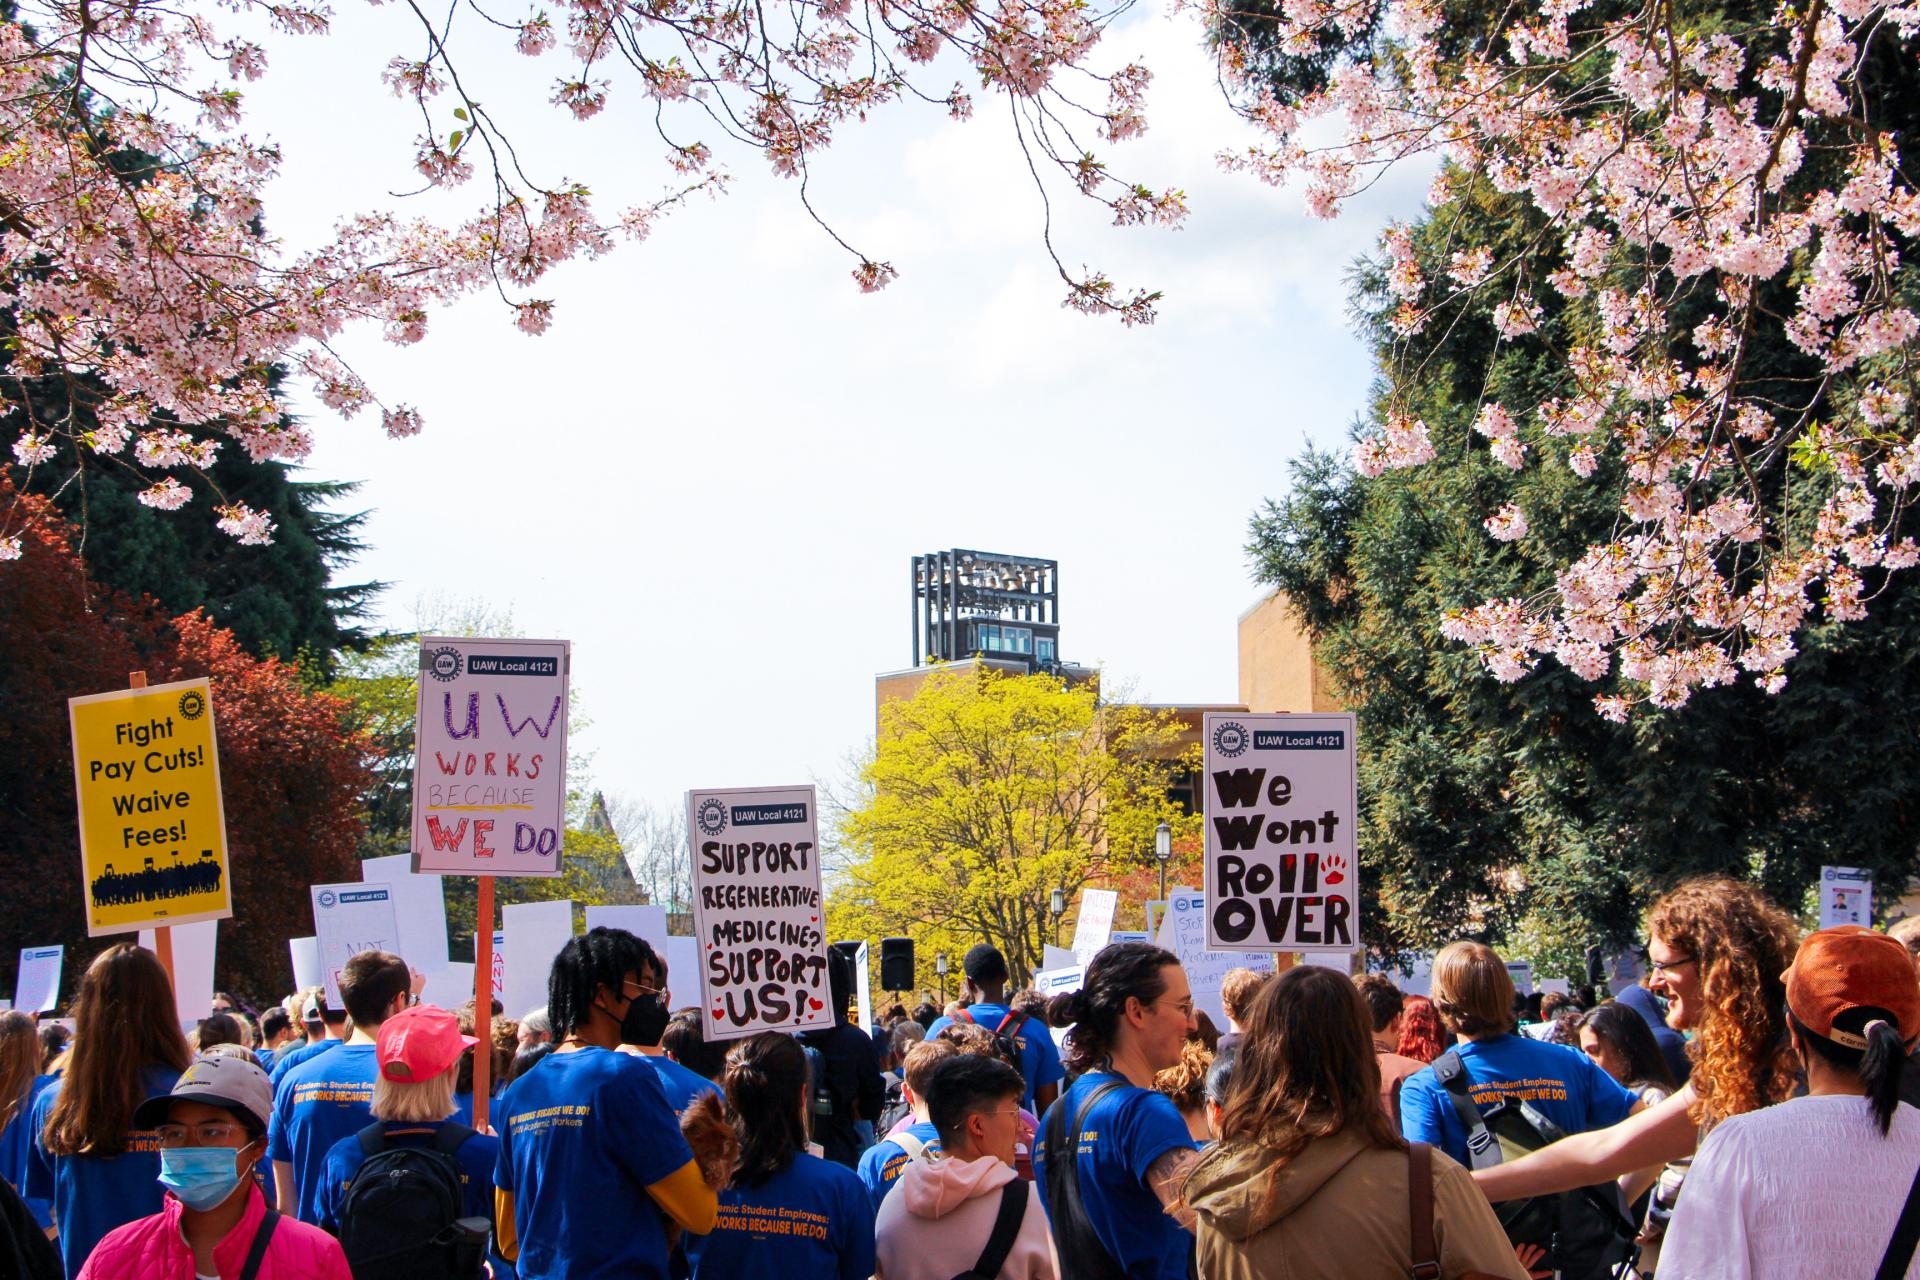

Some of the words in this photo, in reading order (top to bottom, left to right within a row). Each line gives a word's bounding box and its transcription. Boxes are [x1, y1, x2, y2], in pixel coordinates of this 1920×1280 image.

[472, 660, 498, 671] UAW
[500, 661, 528, 671] Local
[529, 662, 553, 672] 4121
[443, 691, 561, 740] UW
[115, 717, 173, 747] Fight
[1222, 735, 1239, 744] UAW
[1258, 735, 1284, 746] UAW
[1285, 735, 1314, 746] Local
[1316, 735, 1340, 746] 4121
[90, 760, 135, 782] Pay
[144, 744, 204, 773] Cuts!
[435, 751, 543, 779] WORKS
[429, 784, 536, 807] BECAUSE
[1212, 767, 1292, 808] We
[112, 790, 190, 816] Waive
[735, 811, 757, 822] UAW
[758, 810, 782, 821] Local
[783, 808, 804, 819] 4121
[123, 820, 187, 848] Fees!
[425, 815, 495, 858] WE
[513, 821, 557, 857] DO
[1213, 811, 1339, 850] Wont
[702, 841, 813, 875] SUPPORT
[1217, 853, 1319, 897] Roll
[701, 885, 819, 910] REGENERATIVE
[1213, 894, 1351, 944] OVER
[713, 920, 820, 952] MEDICINE?
[709, 948, 826, 988] SUPPORT
[725, 983, 808, 1027] US!
[305, 1090, 334, 1102] WORKS
[335, 1090, 371, 1102] BECAUSE
[329, 1081, 360, 1089] Student
[1472, 1091, 1503, 1104] WORKS
[1537, 1089, 1550, 1100] WE
[1551, 1089, 1567, 1101] DO!
[1492, 1080, 1521, 1090] Student
[1523, 1078, 1565, 1088] Employees:
[552, 1117, 583, 1127] Workers
[562, 1105, 574, 1115] WE
[575, 1105, 590, 1116] DO!
[741, 1204, 777, 1217] Student
[778, 1207, 829, 1223] Employees:
[713, 1216, 748, 1231] WORKS
[748, 1218, 791, 1235] BECAUSE
[793, 1221, 808, 1237] WE
[808, 1223, 827, 1240] DO!
